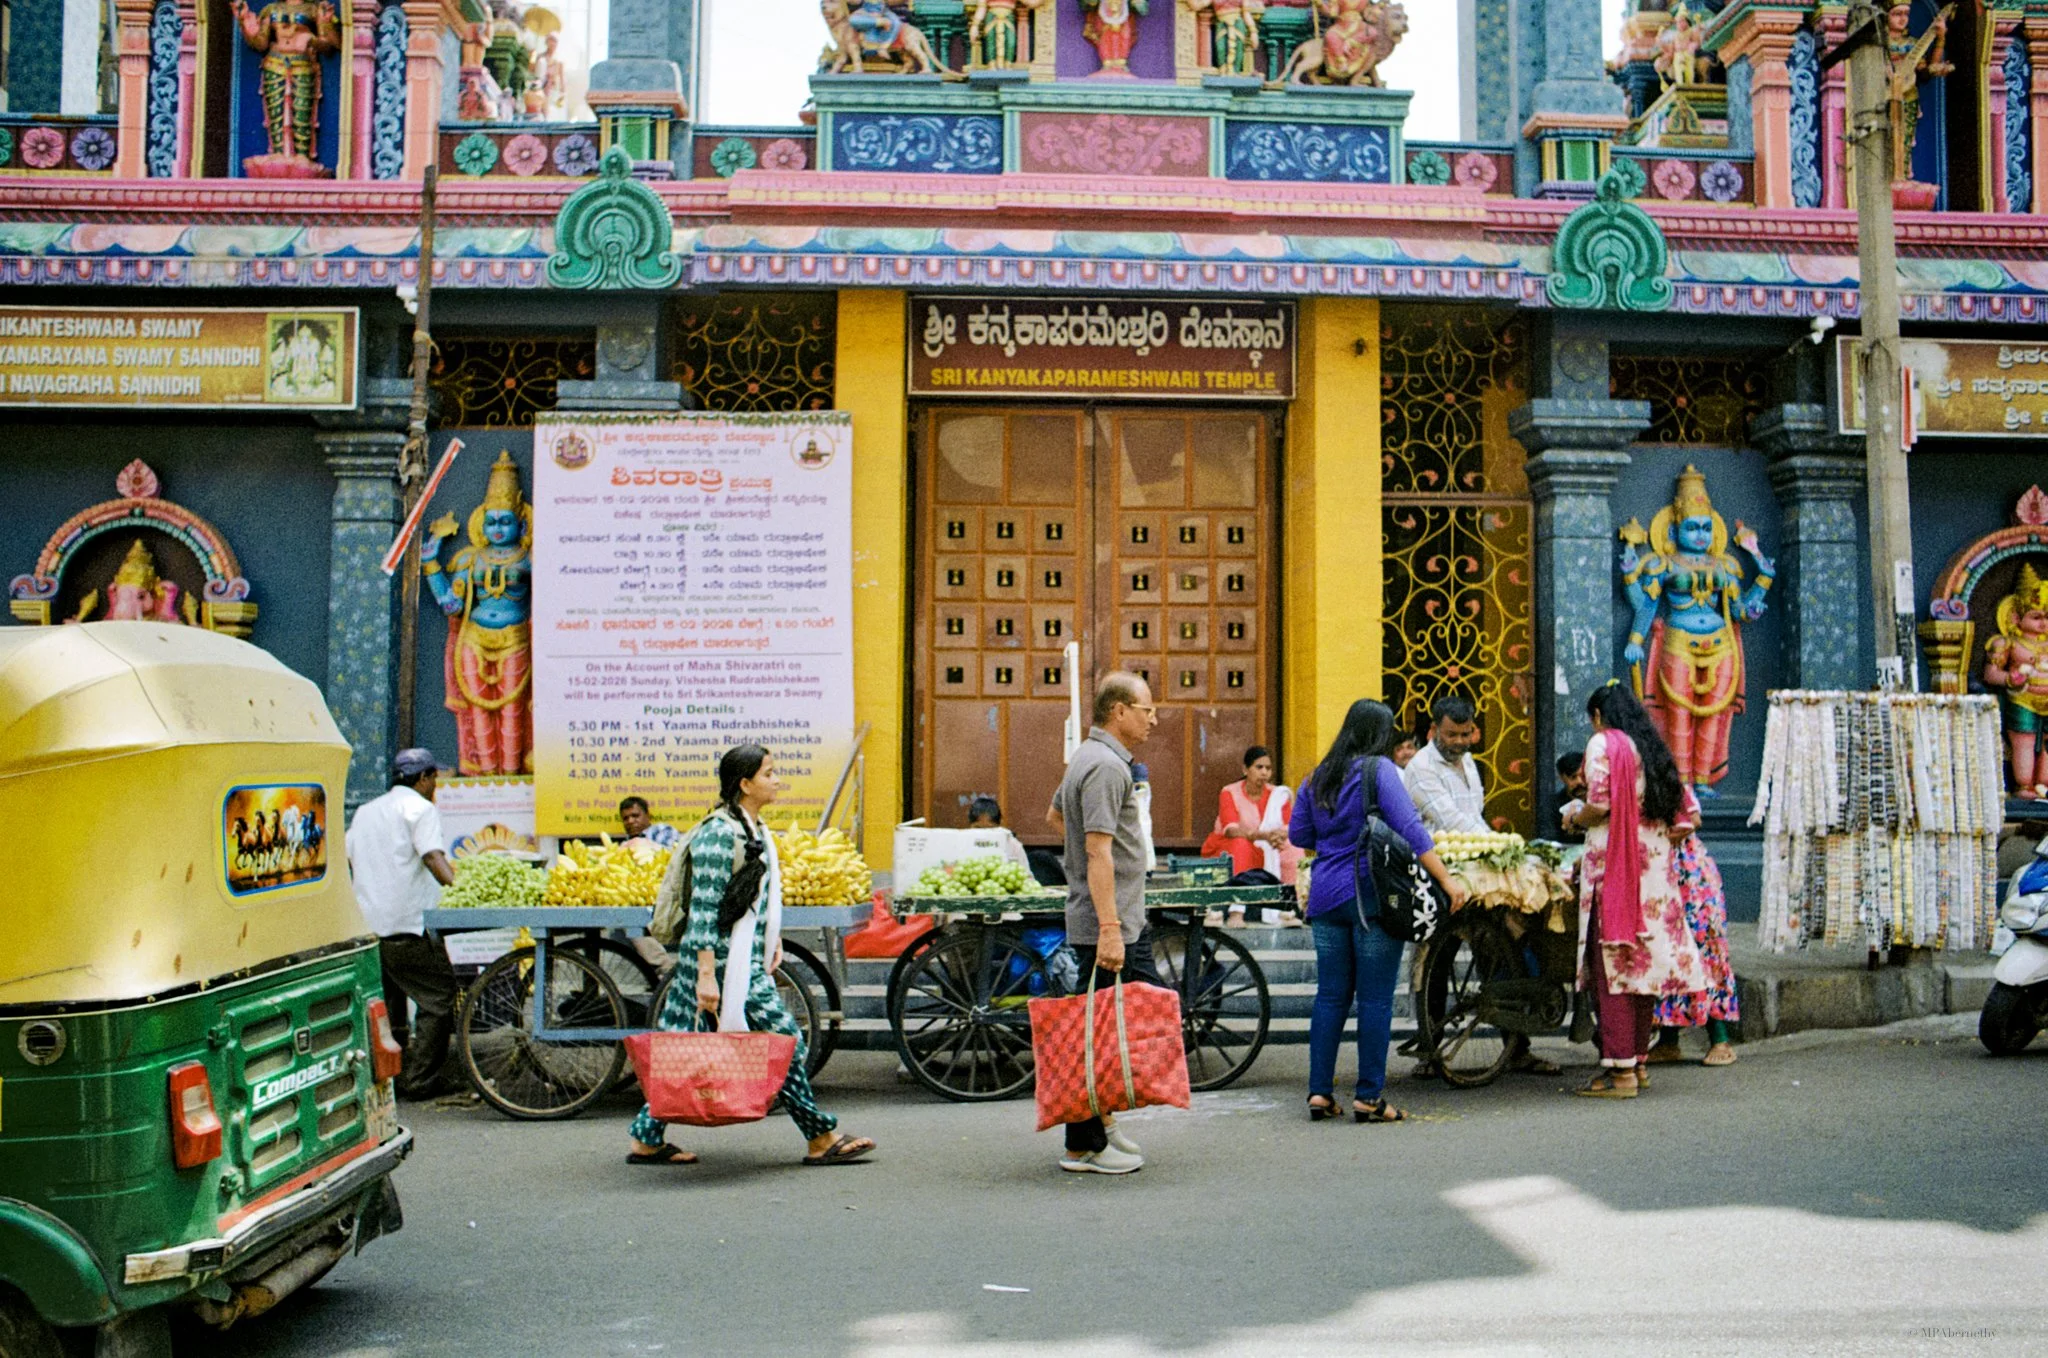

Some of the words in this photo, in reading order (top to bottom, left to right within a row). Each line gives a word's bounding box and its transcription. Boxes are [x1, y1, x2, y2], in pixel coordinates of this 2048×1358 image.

[141, 318, 204, 338] SWAMY
[923, 304, 956, 358] ಶ್ರೀ
[967, 304, 1168, 357] ಕನ್ಯಕಾಪರಮೇಶ್ವರಿ
[1179, 306, 1284, 368] ದೇವಸ್ಥಾನ
[112, 346, 173, 367] SWAMY
[179, 346, 260, 367] SANNIDHI
[10, 374, 115, 394] NAVAGRAHA
[119, 375, 201, 395] SANNIDHI
[931, 368, 962, 386] SRI
[965, 368, 1200, 388] KANYAKAPARAMESHWARI
[1205, 370, 1276, 389] TEMPLE
[2003, 406, 2031, 430] ಶ್ರೀ
[611, 466, 723, 492] ಶಿವರಾತ್ರಿ
[585, 662, 601, 672] On
[604, 662, 622, 672] the
[625, 661, 670, 672] Account
[673, 661, 684, 671] of
[688, 660, 721, 671] Maha
[725, 659, 785, 671] Shivaratri
[788, 662, 802, 670] on
[675, 675, 726, 685] Vishesha
[729, 674, 820, 685] Rudrabhishekam
[564, 690, 584, 700] will
[587, 690, 600, 700] be
[603, 689, 660, 702] performed
[663, 689, 673, 699] to
[677, 688, 693, 699] Sri
[696, 688, 781, 699] Srikanteshwara
[784, 688, 823, 701] Swamy
[643, 704, 682, 717] Pooja
[686, 703, 735, 715] Details
[568, 721, 597, 731] 5.30
[601, 720, 620, 731] PM
[635, 721, 654, 731] 1st
[662, 720, 707, 731] Yaama
[711, 718, 810, 730] Rudrabhisheka
[570, 736, 605, 747] 10.30
[609, 736, 630, 747] PM
[642, 735, 666, 747] 2nd
[674, 735, 719, 746] Yaama
[723, 734, 822, 746] Rudrabhisheka
[569, 752, 597, 763] 1.30
[601, 752, 622, 763] AM
[635, 751, 656, 762] 3rd
[664, 751, 709, 762] Yaama
[568, 768, 598, 779] 4.30
[601, 768, 622, 779] AM
[634, 768, 656, 778] 4th
[664, 767, 709, 778] Yaama
